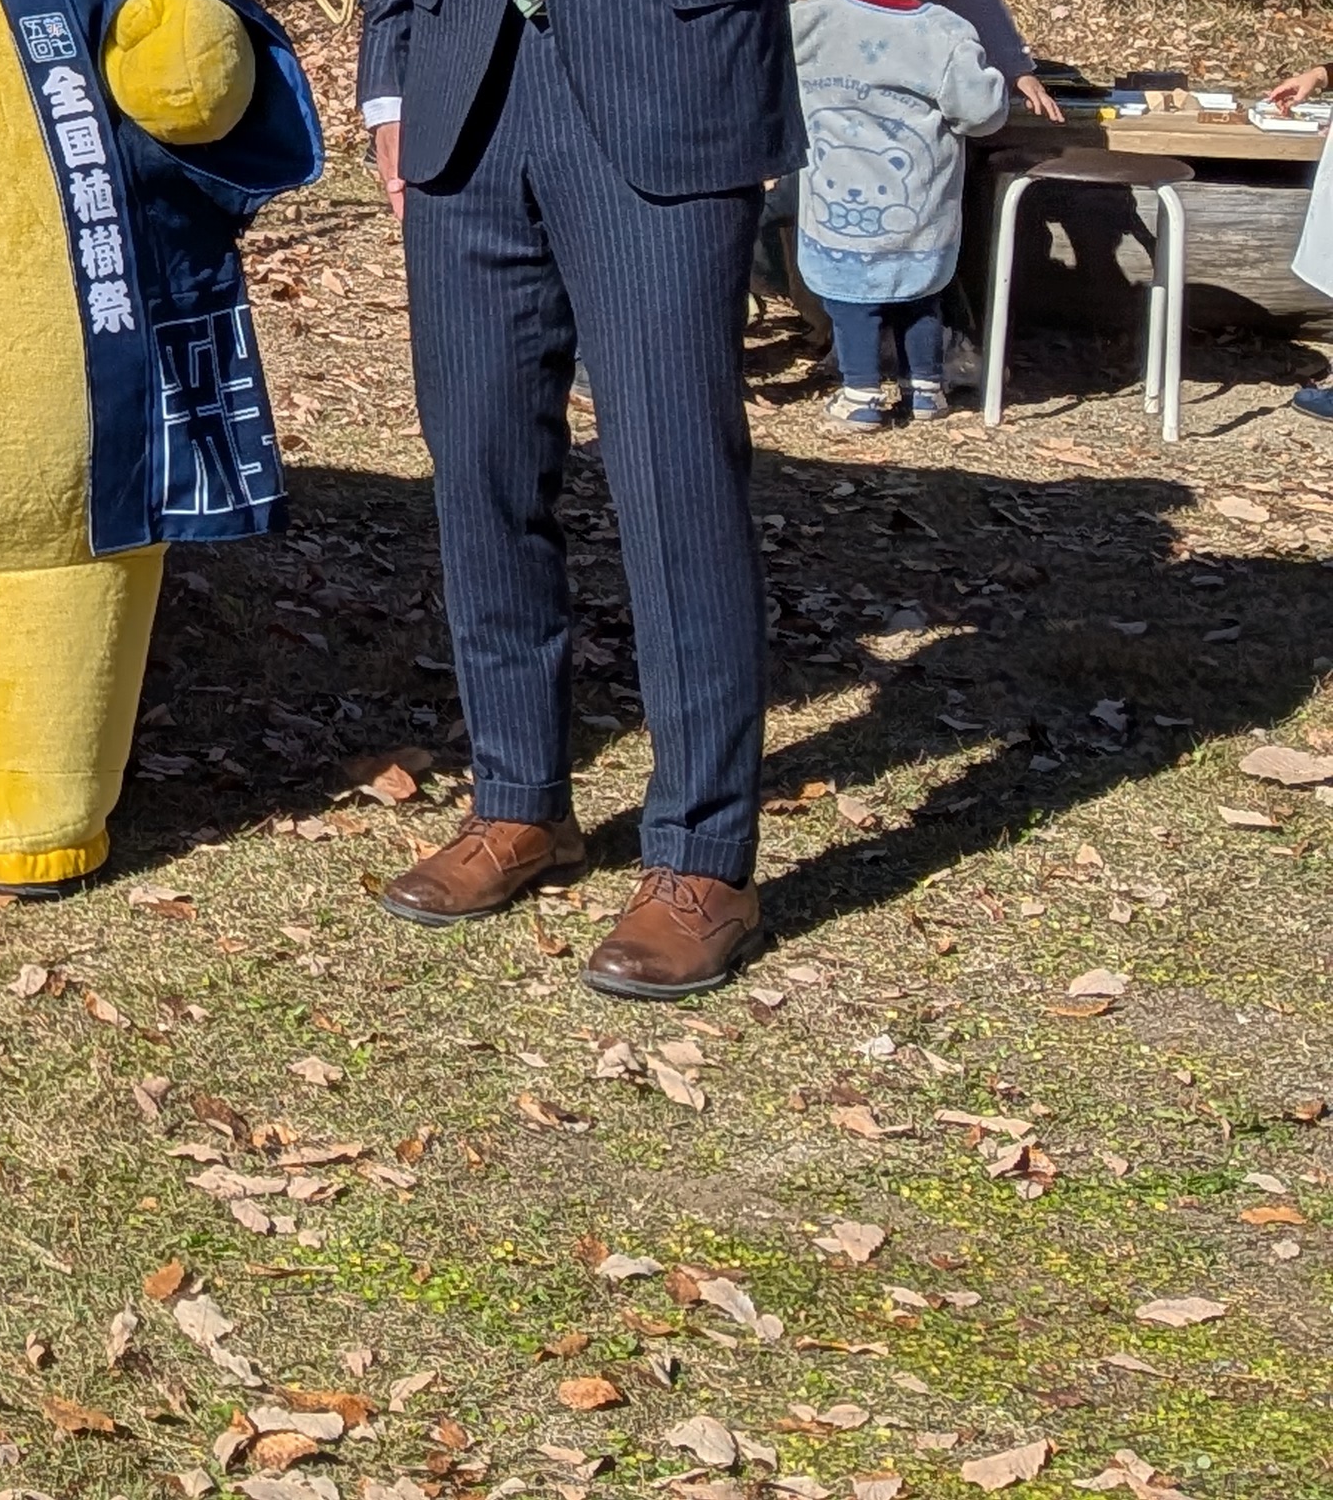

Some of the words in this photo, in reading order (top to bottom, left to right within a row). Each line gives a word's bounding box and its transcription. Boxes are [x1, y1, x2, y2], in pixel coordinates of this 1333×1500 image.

[41, 65, 135, 335] 全国植樹祭
